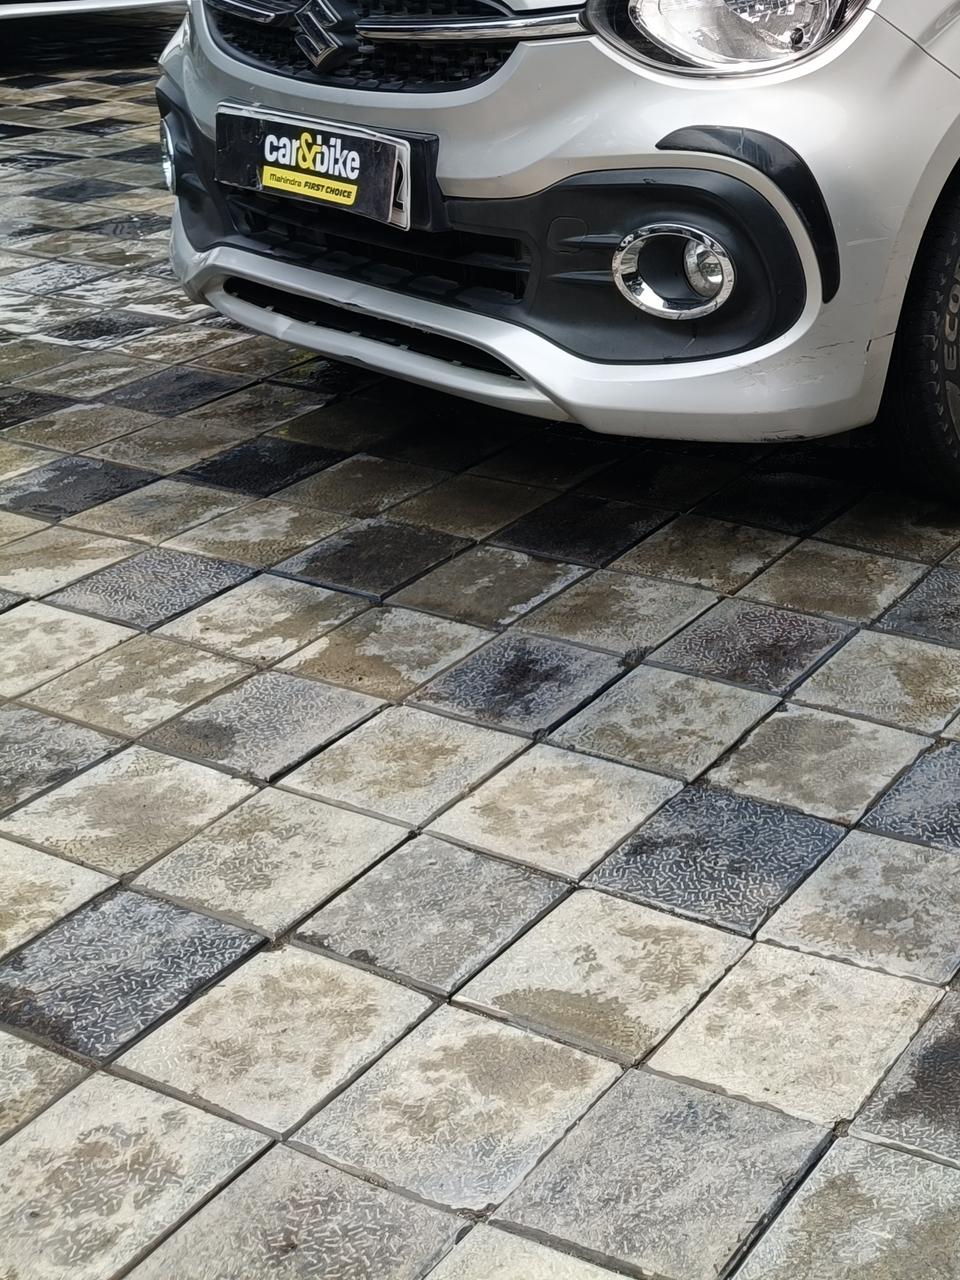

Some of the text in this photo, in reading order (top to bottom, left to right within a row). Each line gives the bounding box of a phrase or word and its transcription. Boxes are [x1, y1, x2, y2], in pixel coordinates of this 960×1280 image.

[264, 131, 360, 180] car&bike
[303, 180, 325, 192] FIRST
[325, 184, 352, 199] CHOICE
